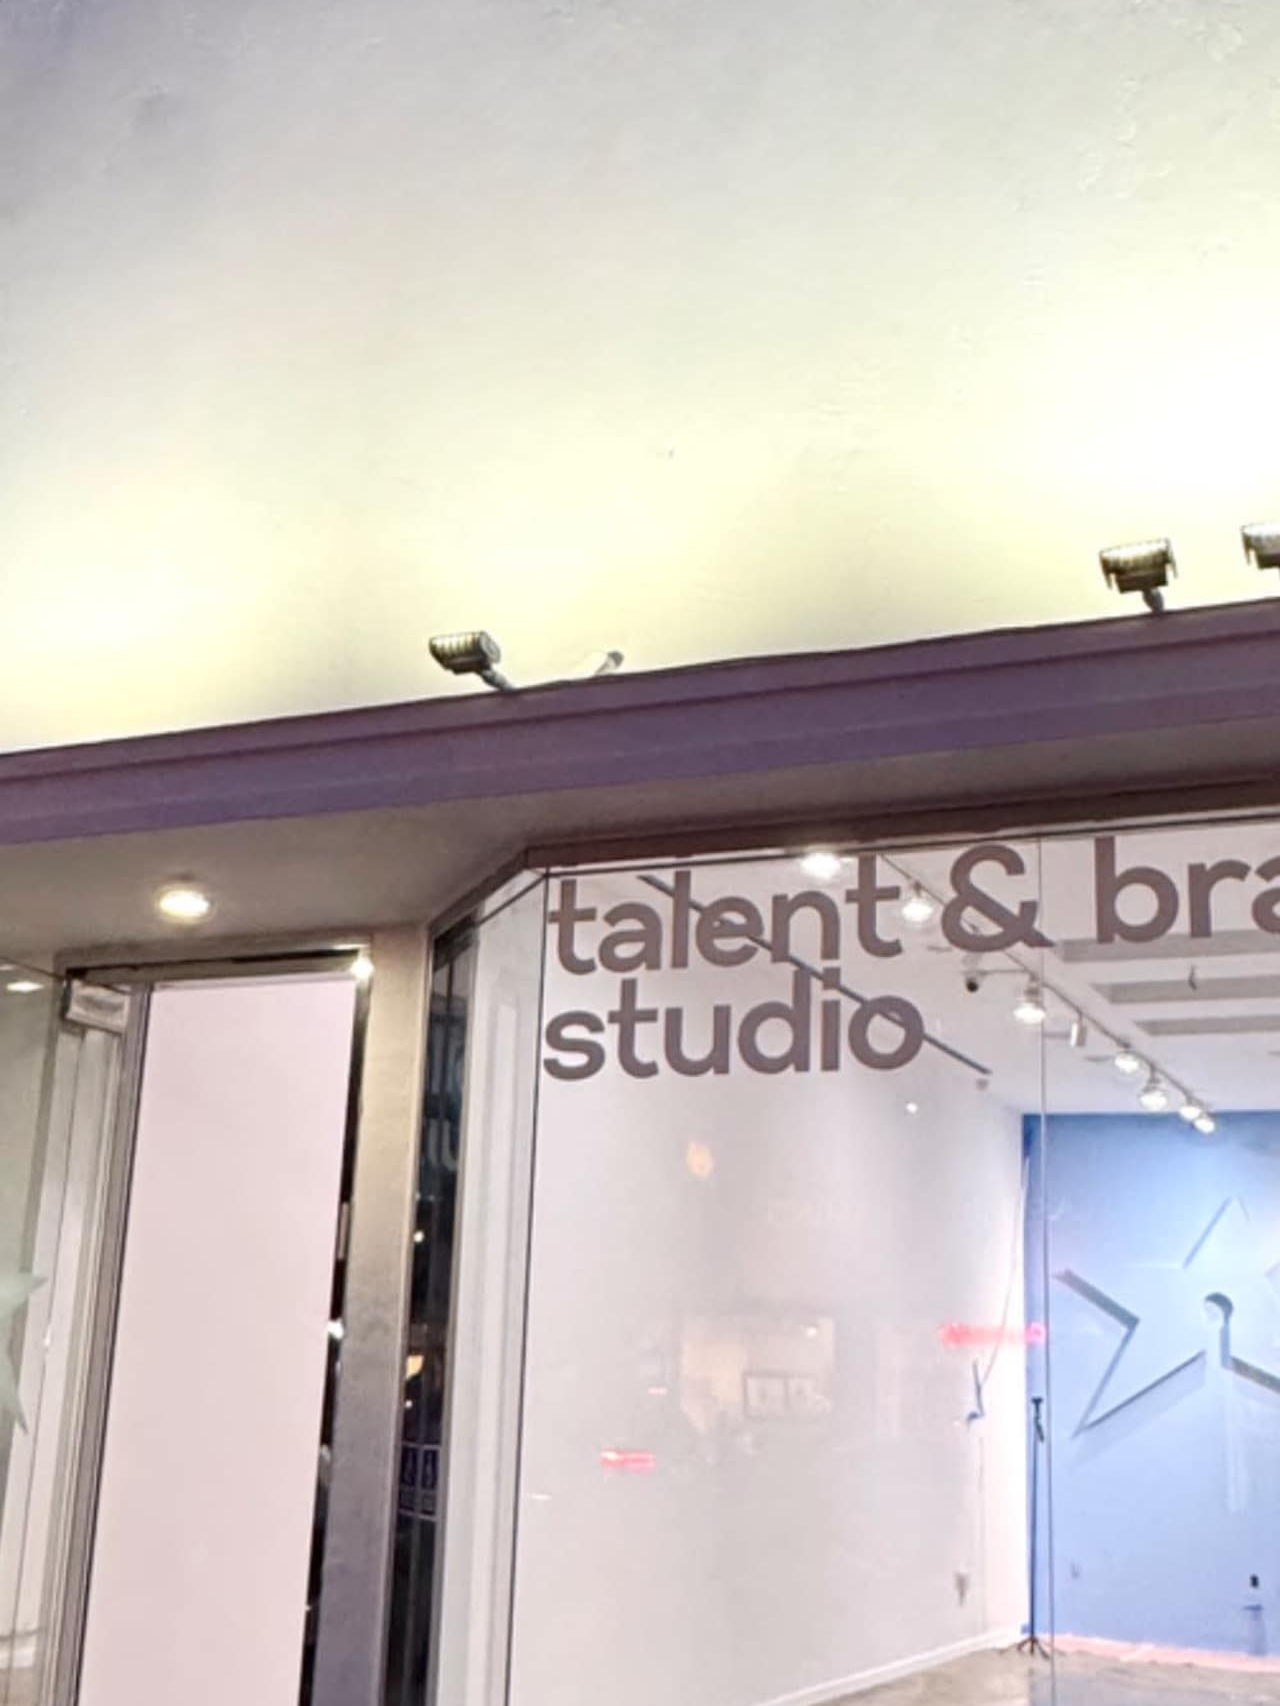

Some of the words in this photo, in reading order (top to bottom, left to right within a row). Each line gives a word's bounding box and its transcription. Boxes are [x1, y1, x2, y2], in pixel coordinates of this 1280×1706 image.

[548, 854, 903, 975] talent
[940, 843, 1056, 952] &
[543, 966, 924, 1081] studio
